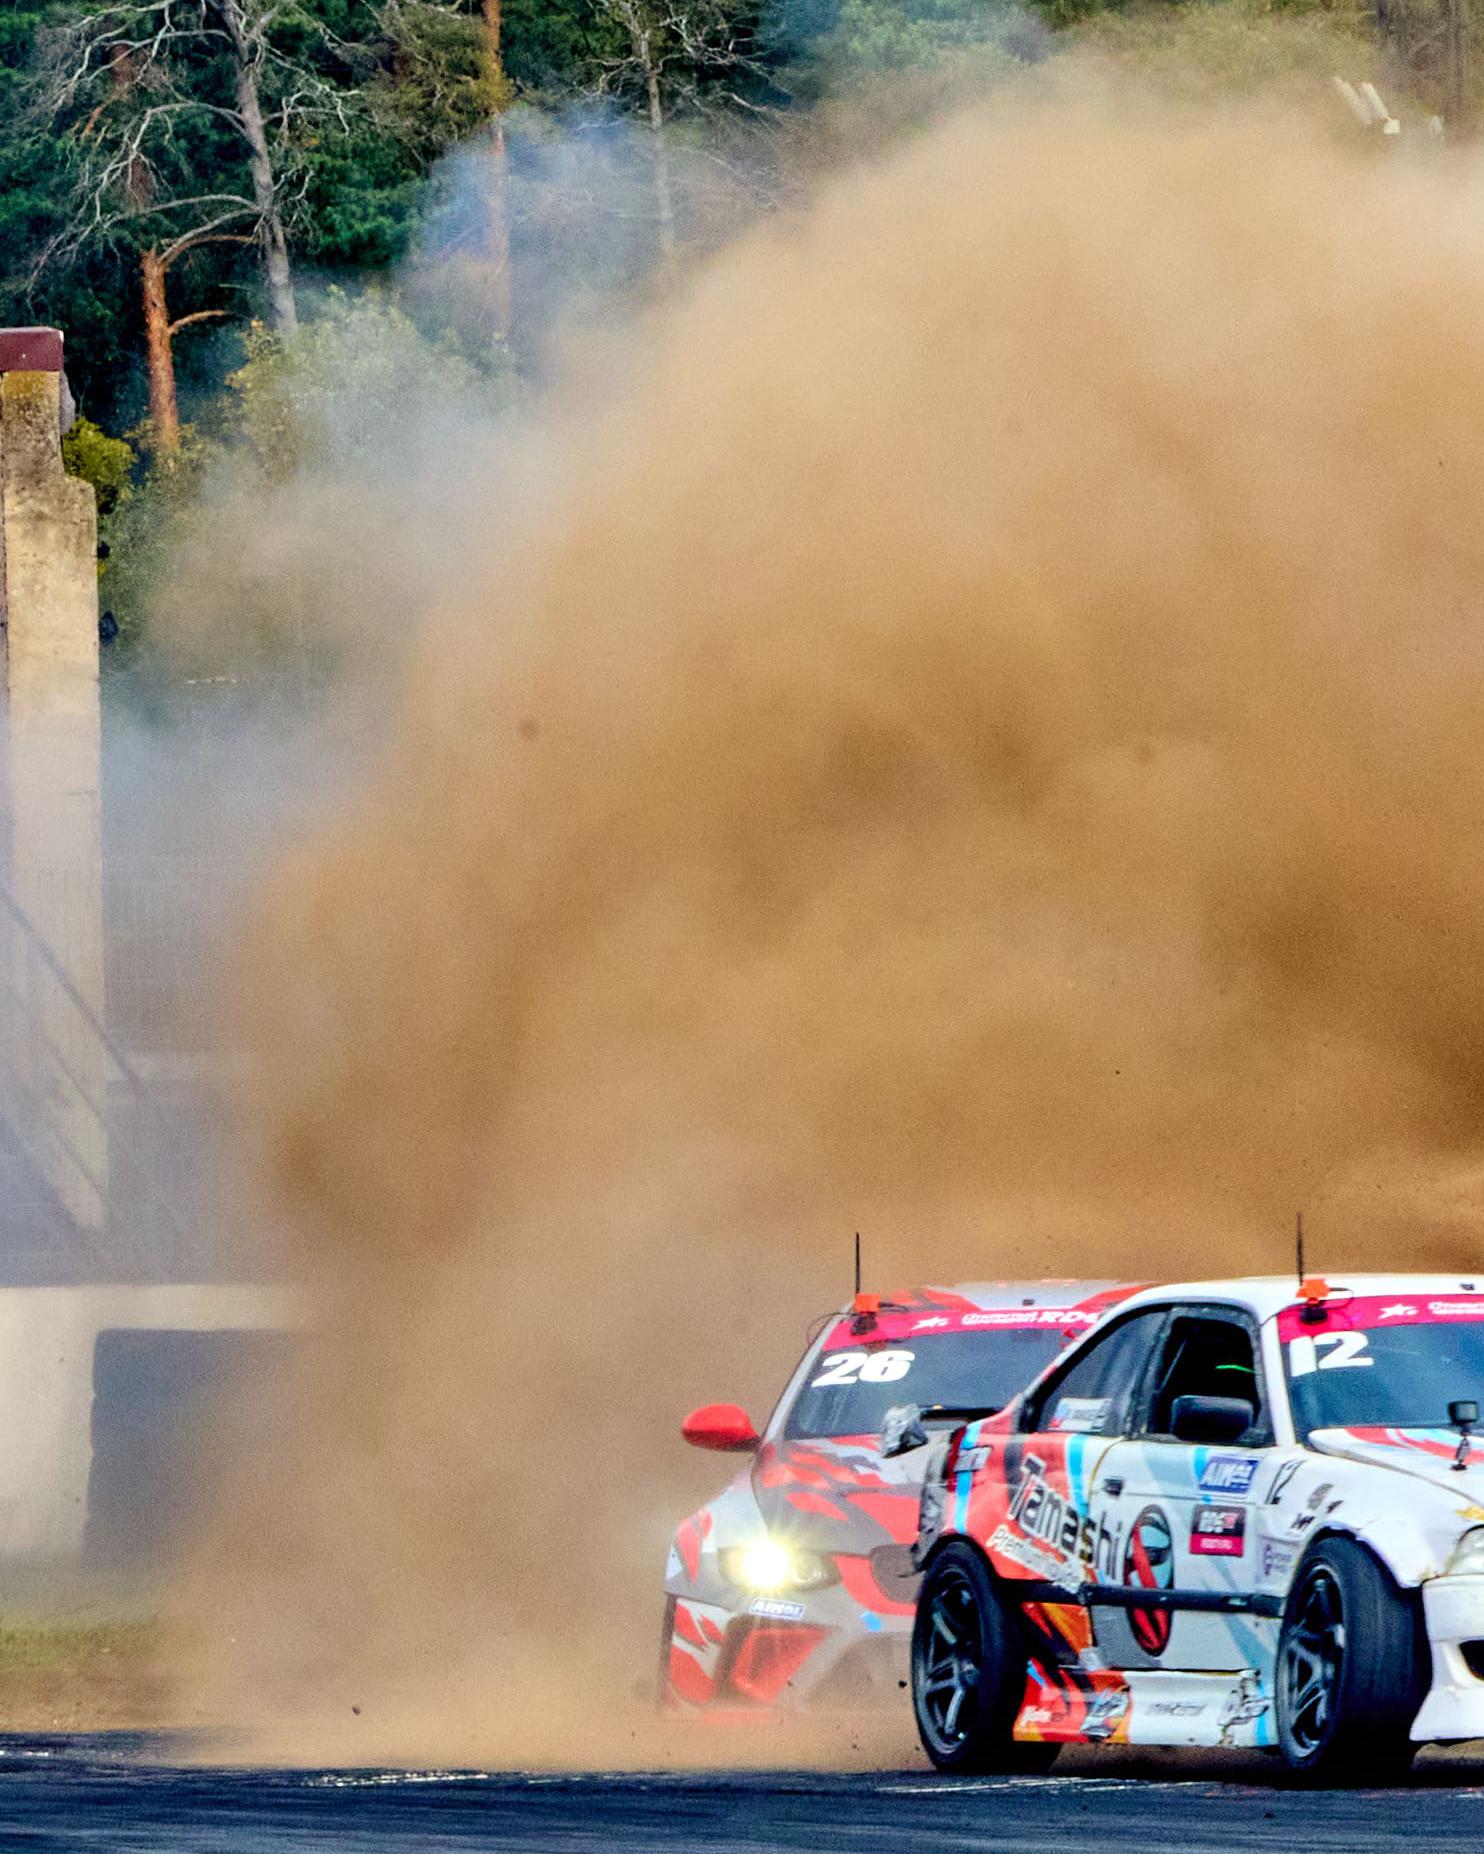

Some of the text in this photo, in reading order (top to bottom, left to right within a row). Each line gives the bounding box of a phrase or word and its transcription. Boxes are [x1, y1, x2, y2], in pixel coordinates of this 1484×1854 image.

[811, 1350, 915, 1388] 26
[1289, 1331, 1374, 1377] 12
[1006, 1452, 1121, 1581] Tamashi
